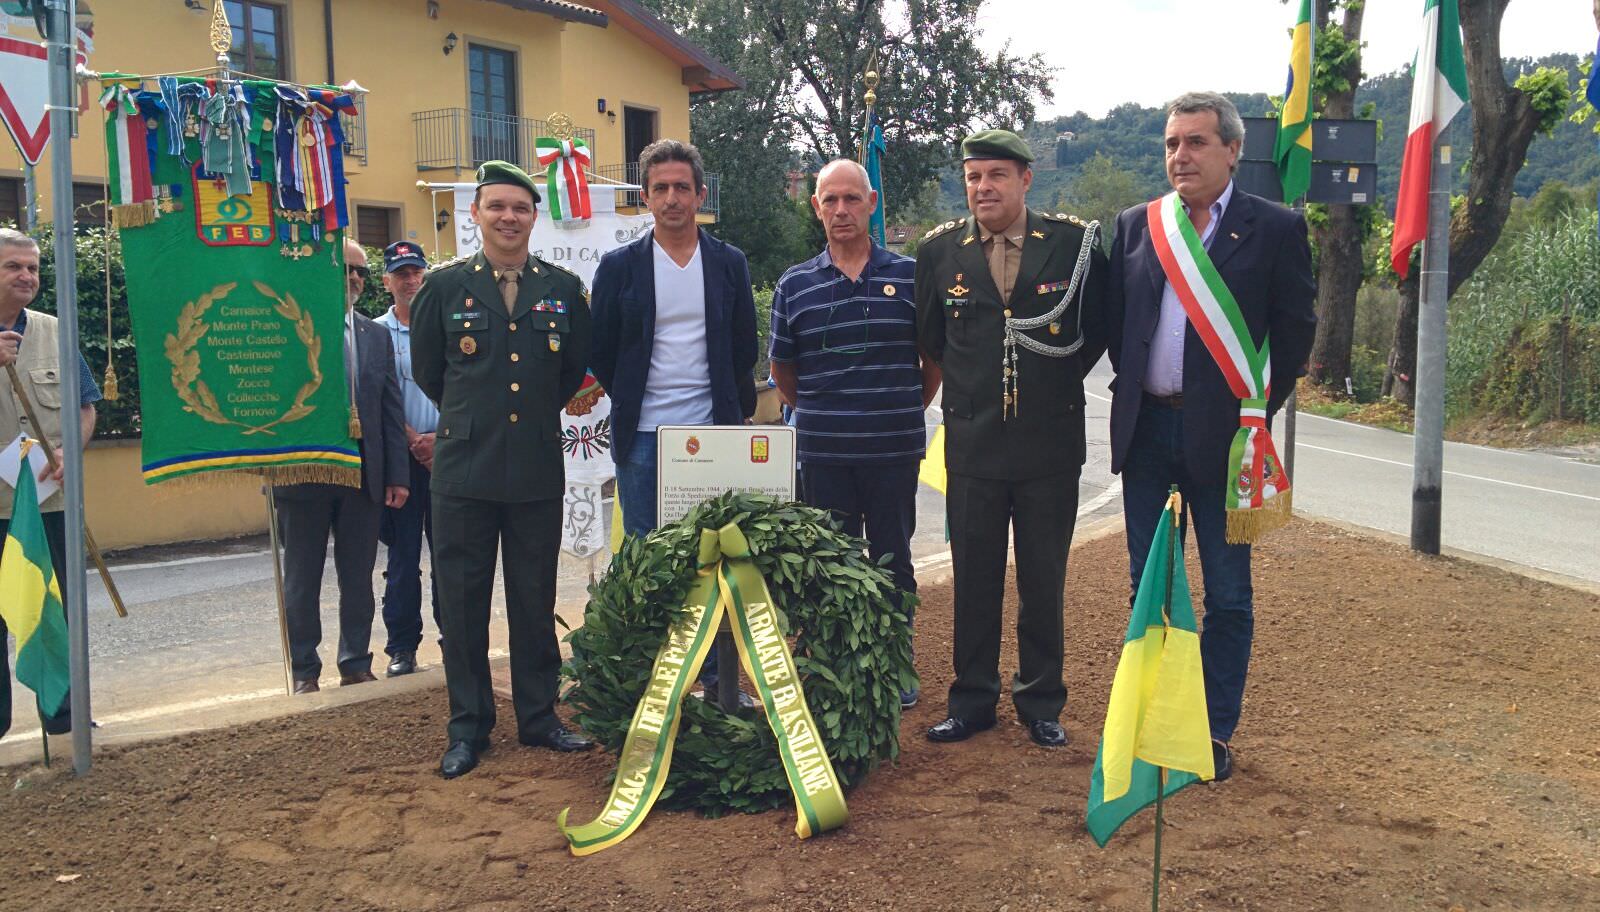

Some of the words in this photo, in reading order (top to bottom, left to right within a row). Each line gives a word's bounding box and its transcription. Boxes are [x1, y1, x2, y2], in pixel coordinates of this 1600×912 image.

[553, 247, 571, 260] DI
[579, 247, 608, 262] CA
[221, 305, 271, 316] Camaiore
[213, 321, 247, 331] Monte
[251, 320, 281, 330] Prano
[208, 336, 242, 346] Monte
[246, 334, 287, 345] Castello
[217, 349, 281, 360] Castelnuovo
[229, 364, 274, 374] Montese
[237, 378, 270, 388] Zocca
[227, 392, 279, 403] Collecchio
[233, 407, 277, 417] Fornovo
[747, 602, 791, 685] ARMATE
[637, 666, 682, 734] DELLE
[661, 604, 706, 666] FOE
